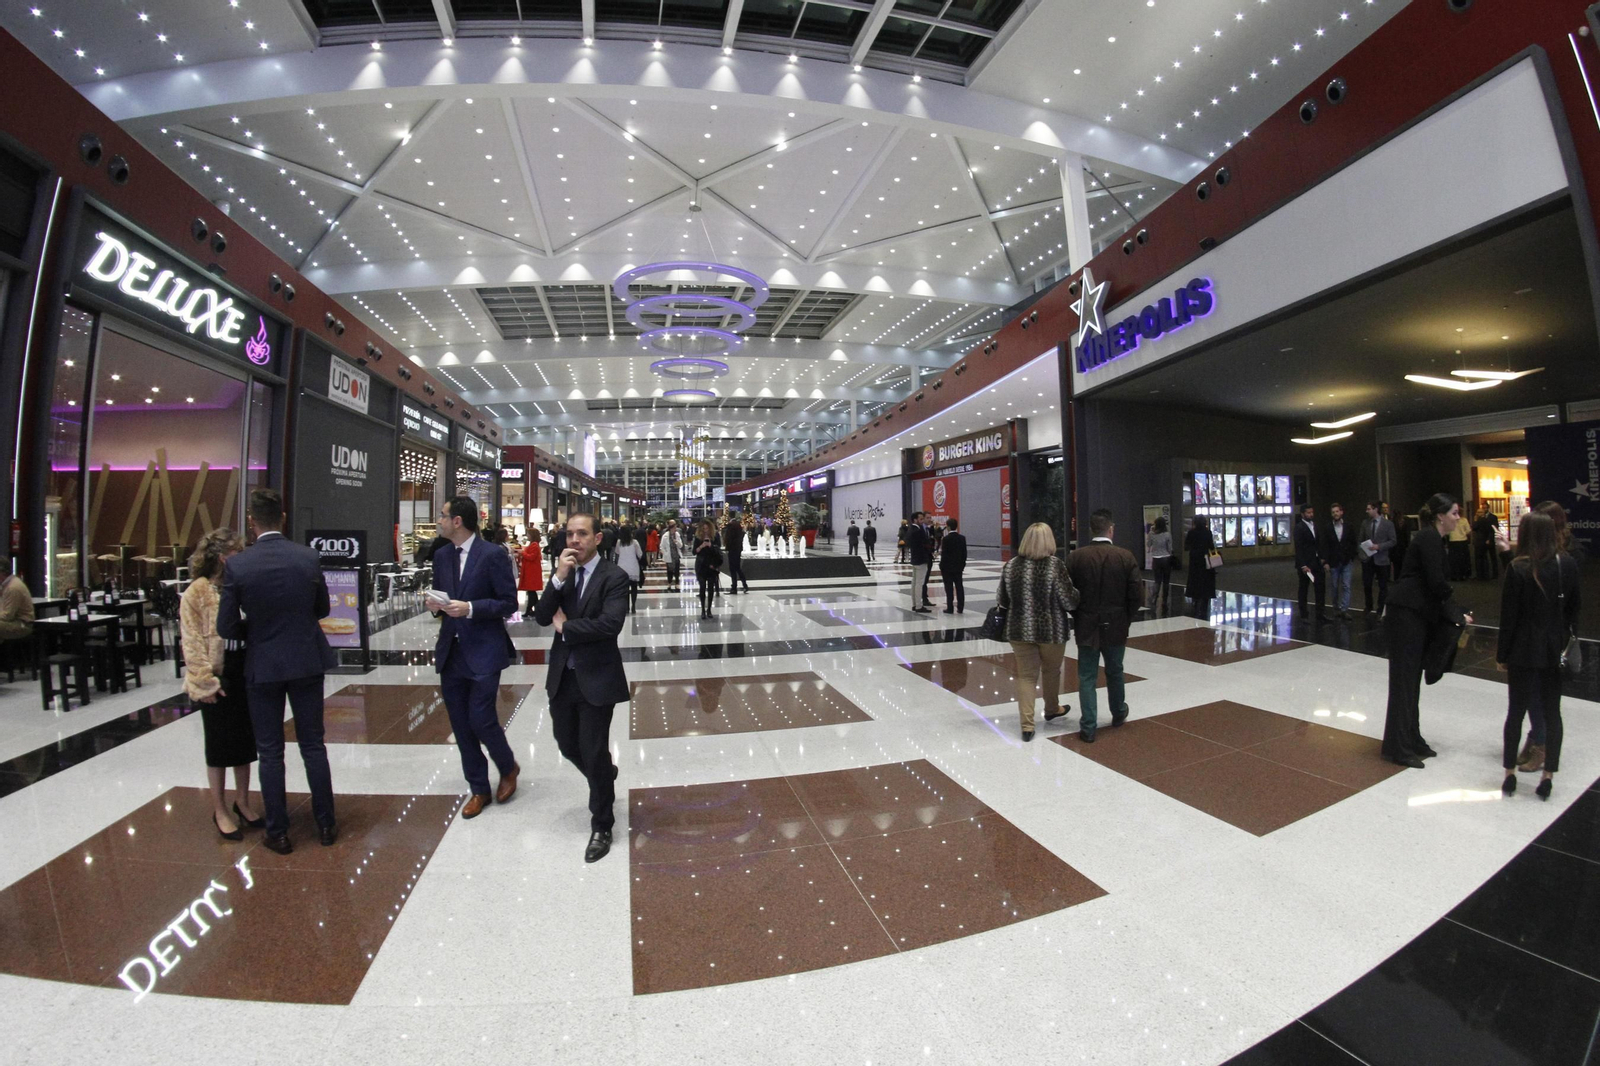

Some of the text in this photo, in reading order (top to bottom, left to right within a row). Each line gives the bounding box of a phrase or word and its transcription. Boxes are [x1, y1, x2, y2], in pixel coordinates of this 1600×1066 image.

[84, 231, 246, 344] DELUXE
[1075, 277, 1217, 375] KINEPOLIS
[332, 367, 367, 404] UDON
[331, 444, 368, 472] UDON
[939, 433, 1002, 461] BURGER KING
[1586, 428, 1600, 502] KINEPOLIS
[1566, 519, 1600, 529] enidos
[319, 539, 350, 551] 100
